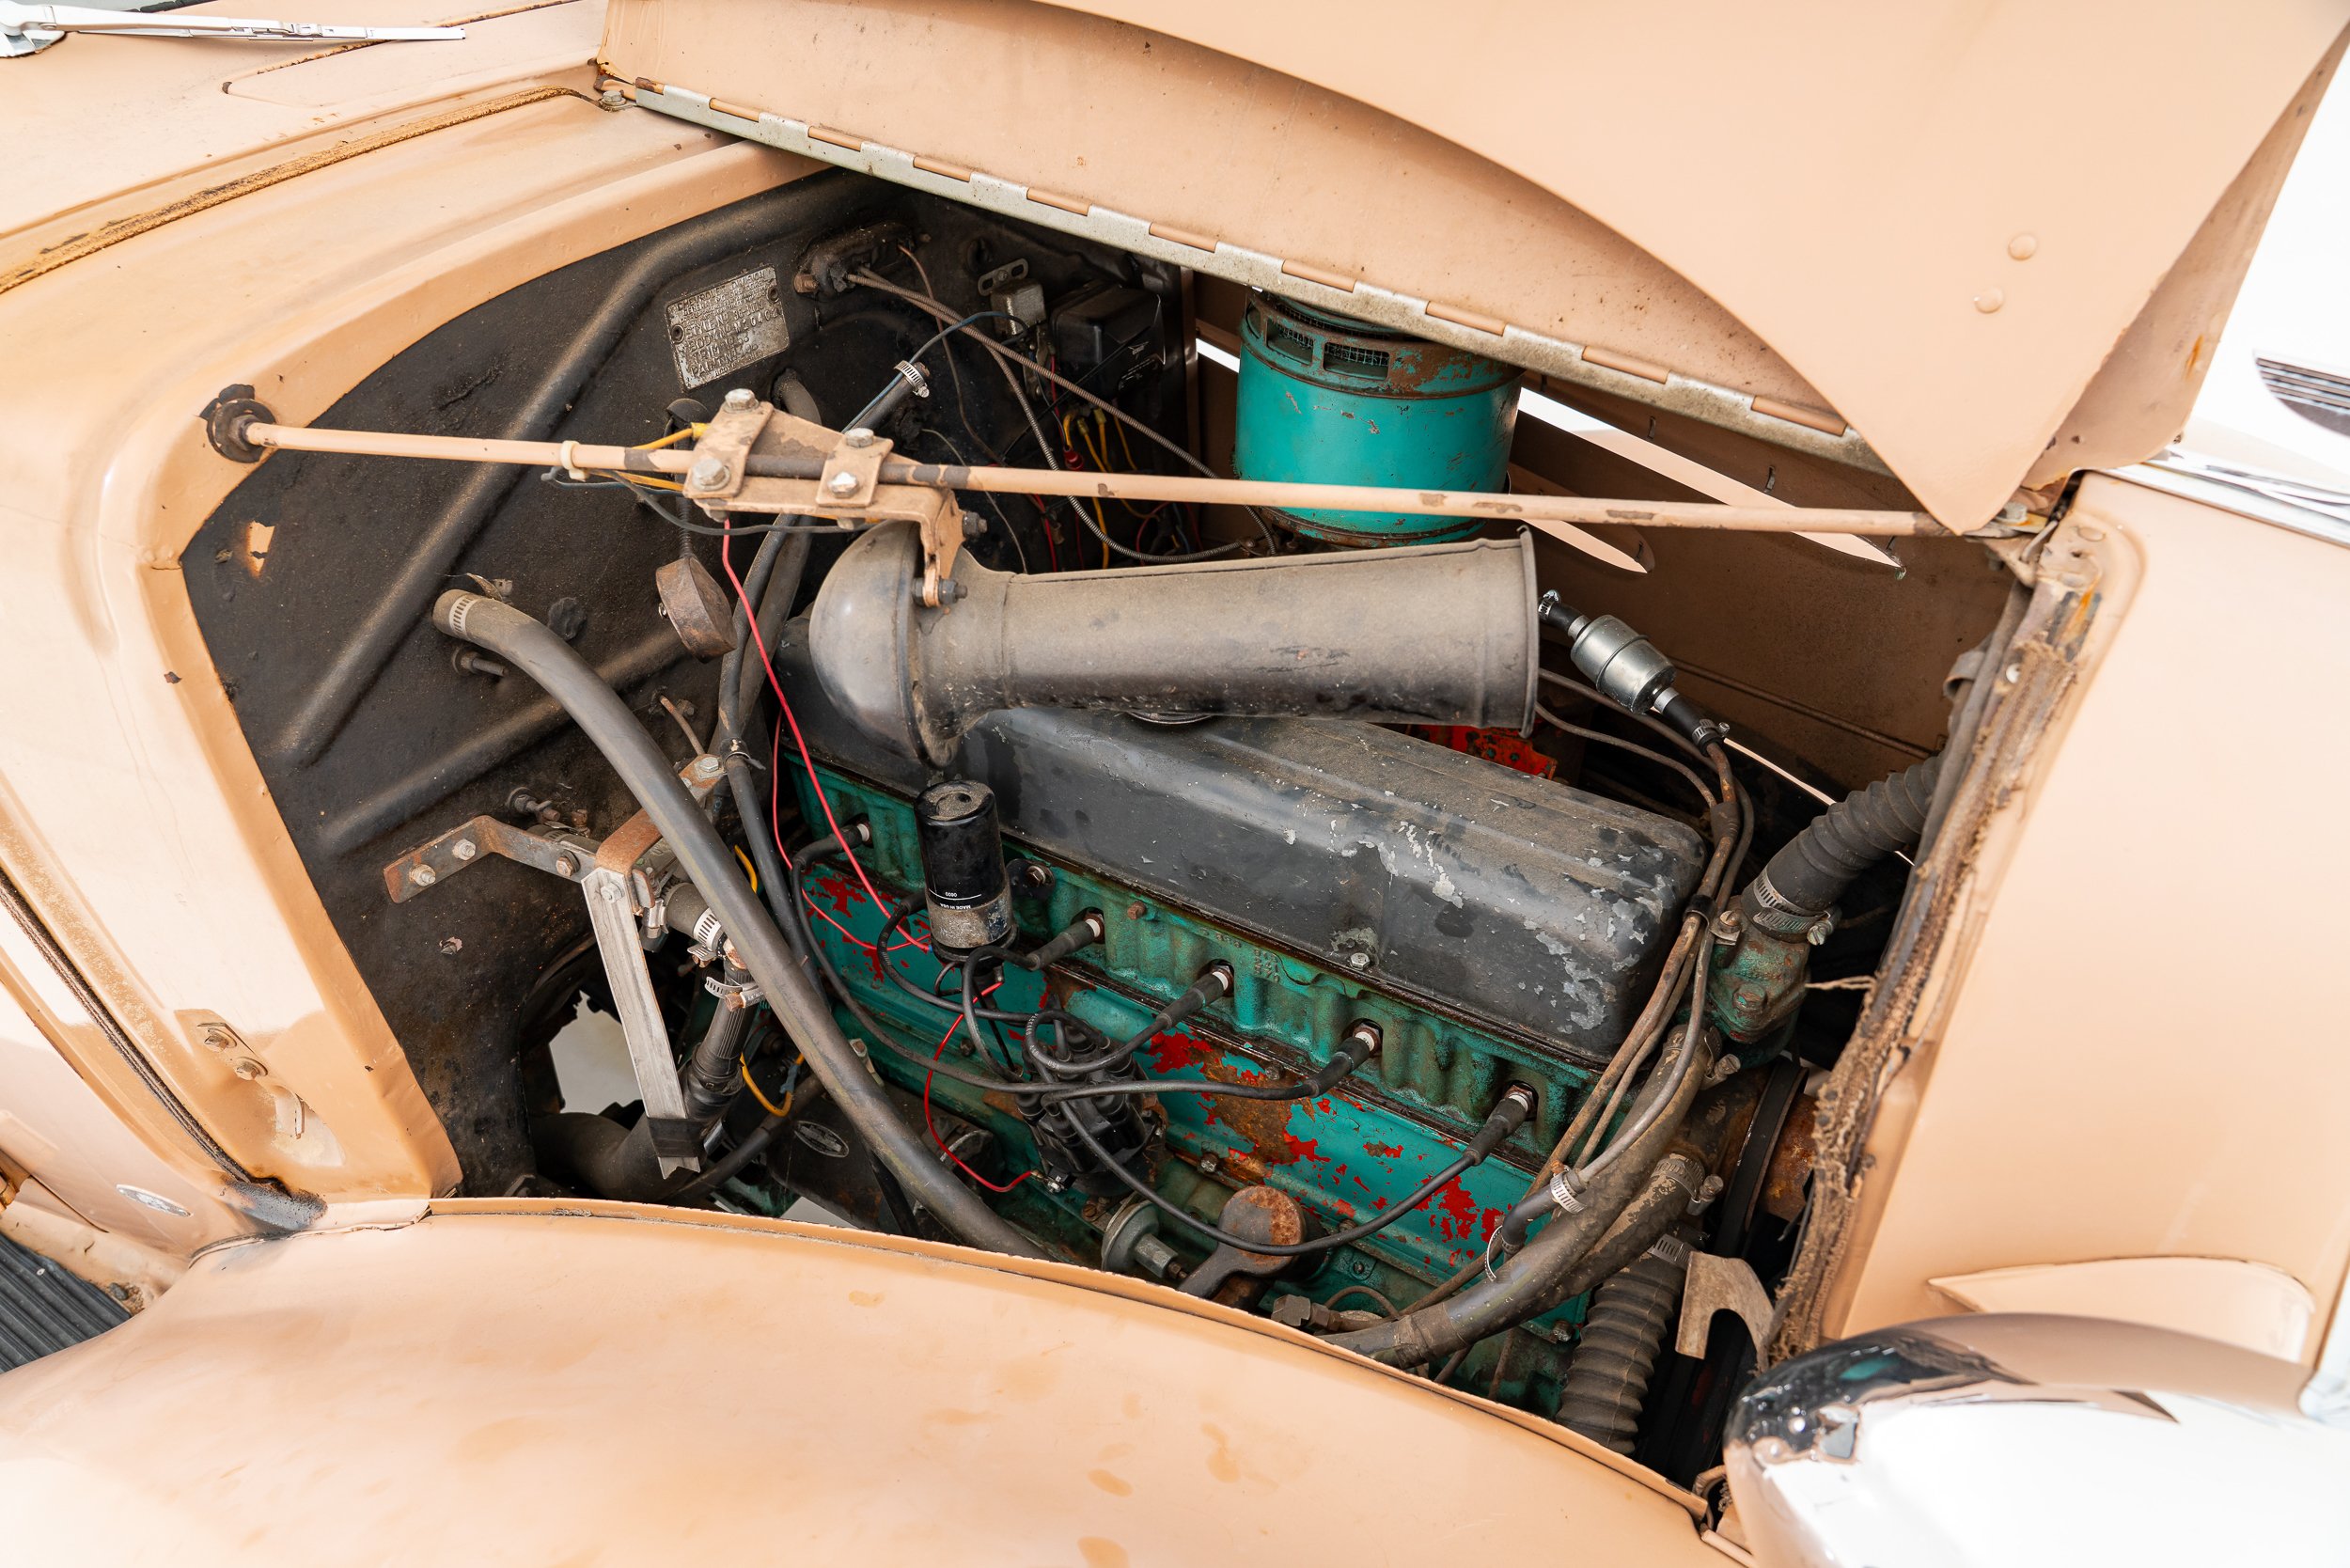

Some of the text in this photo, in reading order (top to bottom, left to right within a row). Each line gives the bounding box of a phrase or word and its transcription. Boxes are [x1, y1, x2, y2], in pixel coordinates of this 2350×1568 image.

[676, 285, 726, 311] CHEVROLET
[684, 317, 715, 338] STYLE
[687, 330, 719, 353] BODY
[691, 342, 720, 365] TRIM
[690, 354, 723, 378] PAINT
